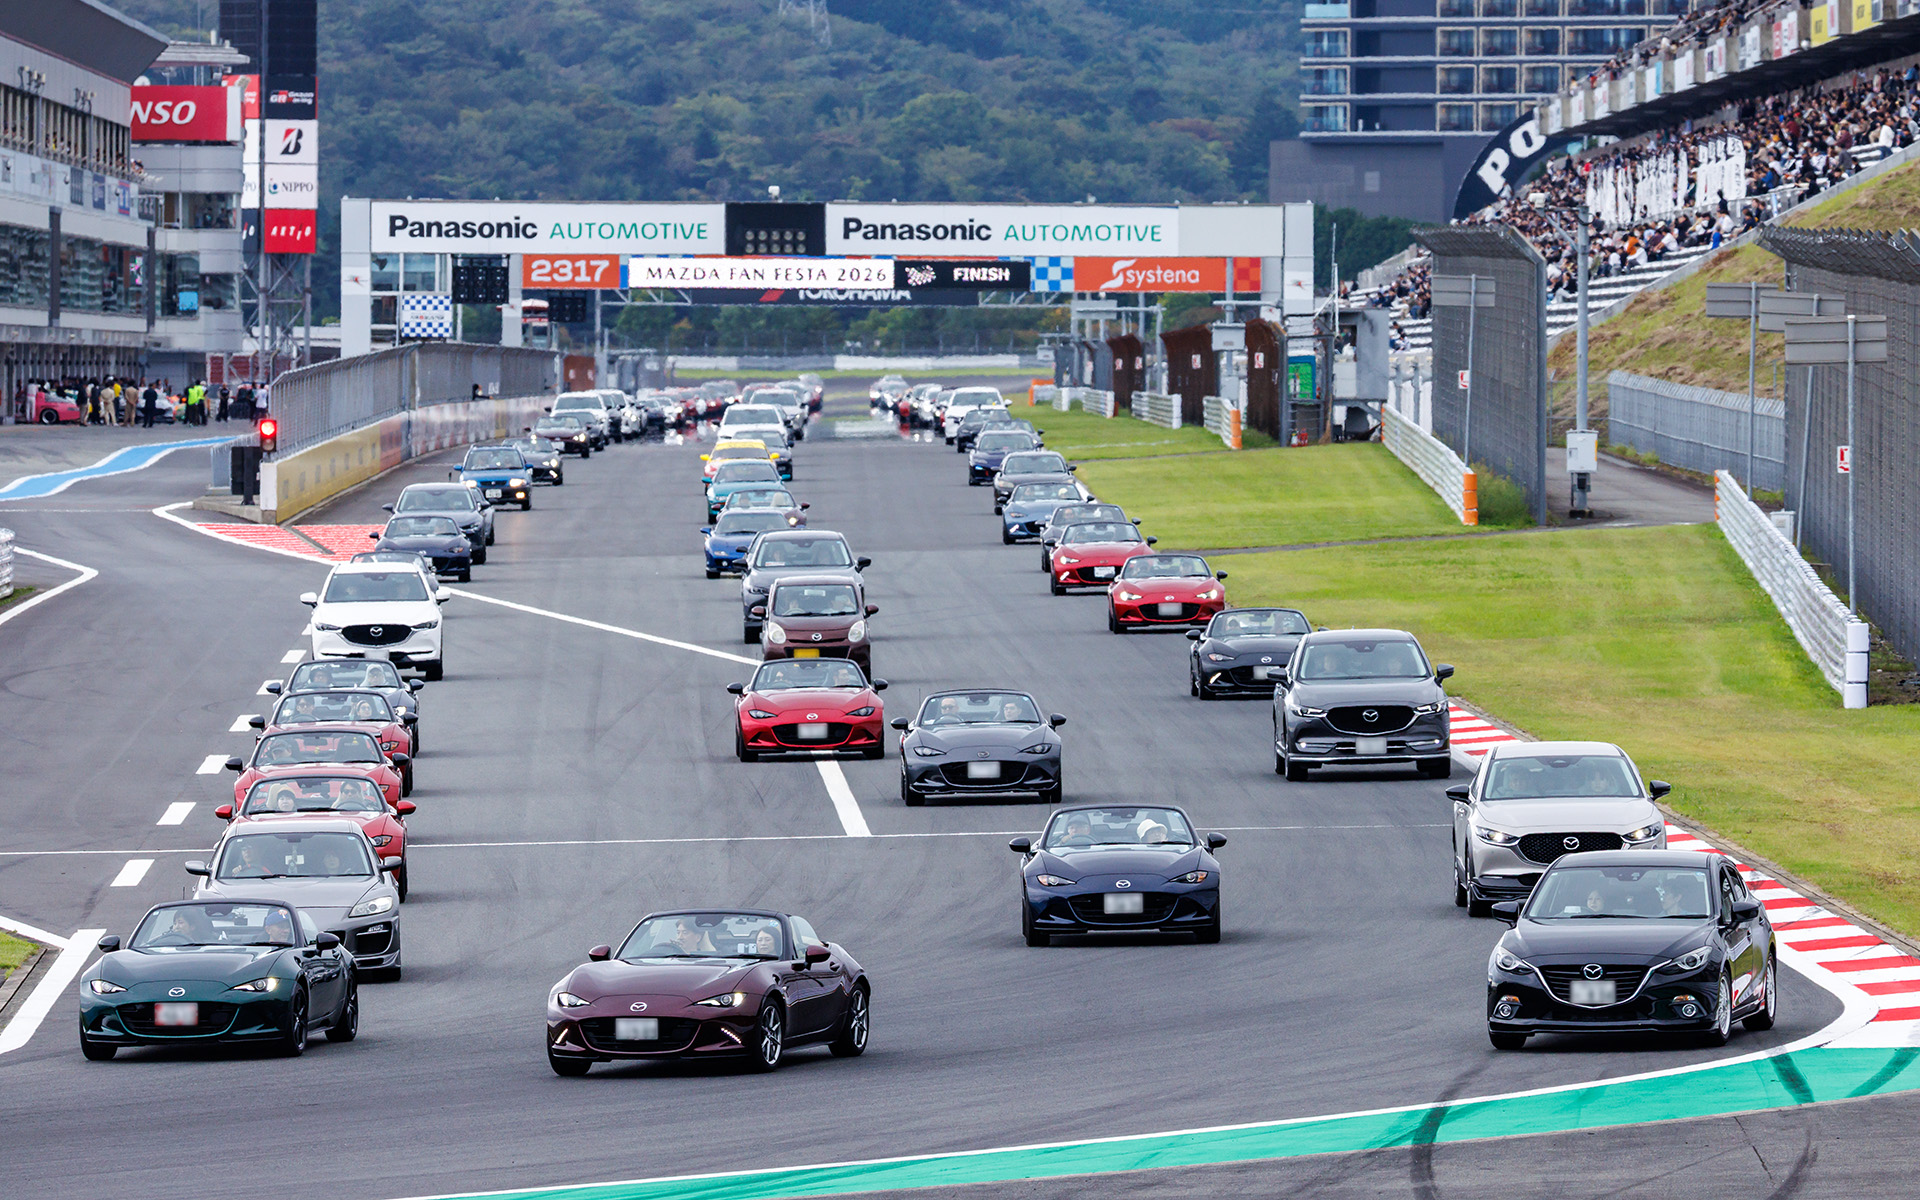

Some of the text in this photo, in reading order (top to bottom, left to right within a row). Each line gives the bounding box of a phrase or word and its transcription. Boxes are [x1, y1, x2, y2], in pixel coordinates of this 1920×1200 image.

[131, 101, 196, 125] NSO
[1477, 119, 1547, 195] PO
[281, 181, 314, 193] NIPPO
[388, 215, 709, 240] Panasonic AUTOMOTIVE
[842, 217, 1162, 242] Panasonic AUTOMOTIVE
[530, 259, 610, 283] 2317
[646, 267, 887, 281] MAZDA FAN FESTA 2026
[953, 267, 1011, 281] FINISH
[1126, 264, 1200, 288] systena
